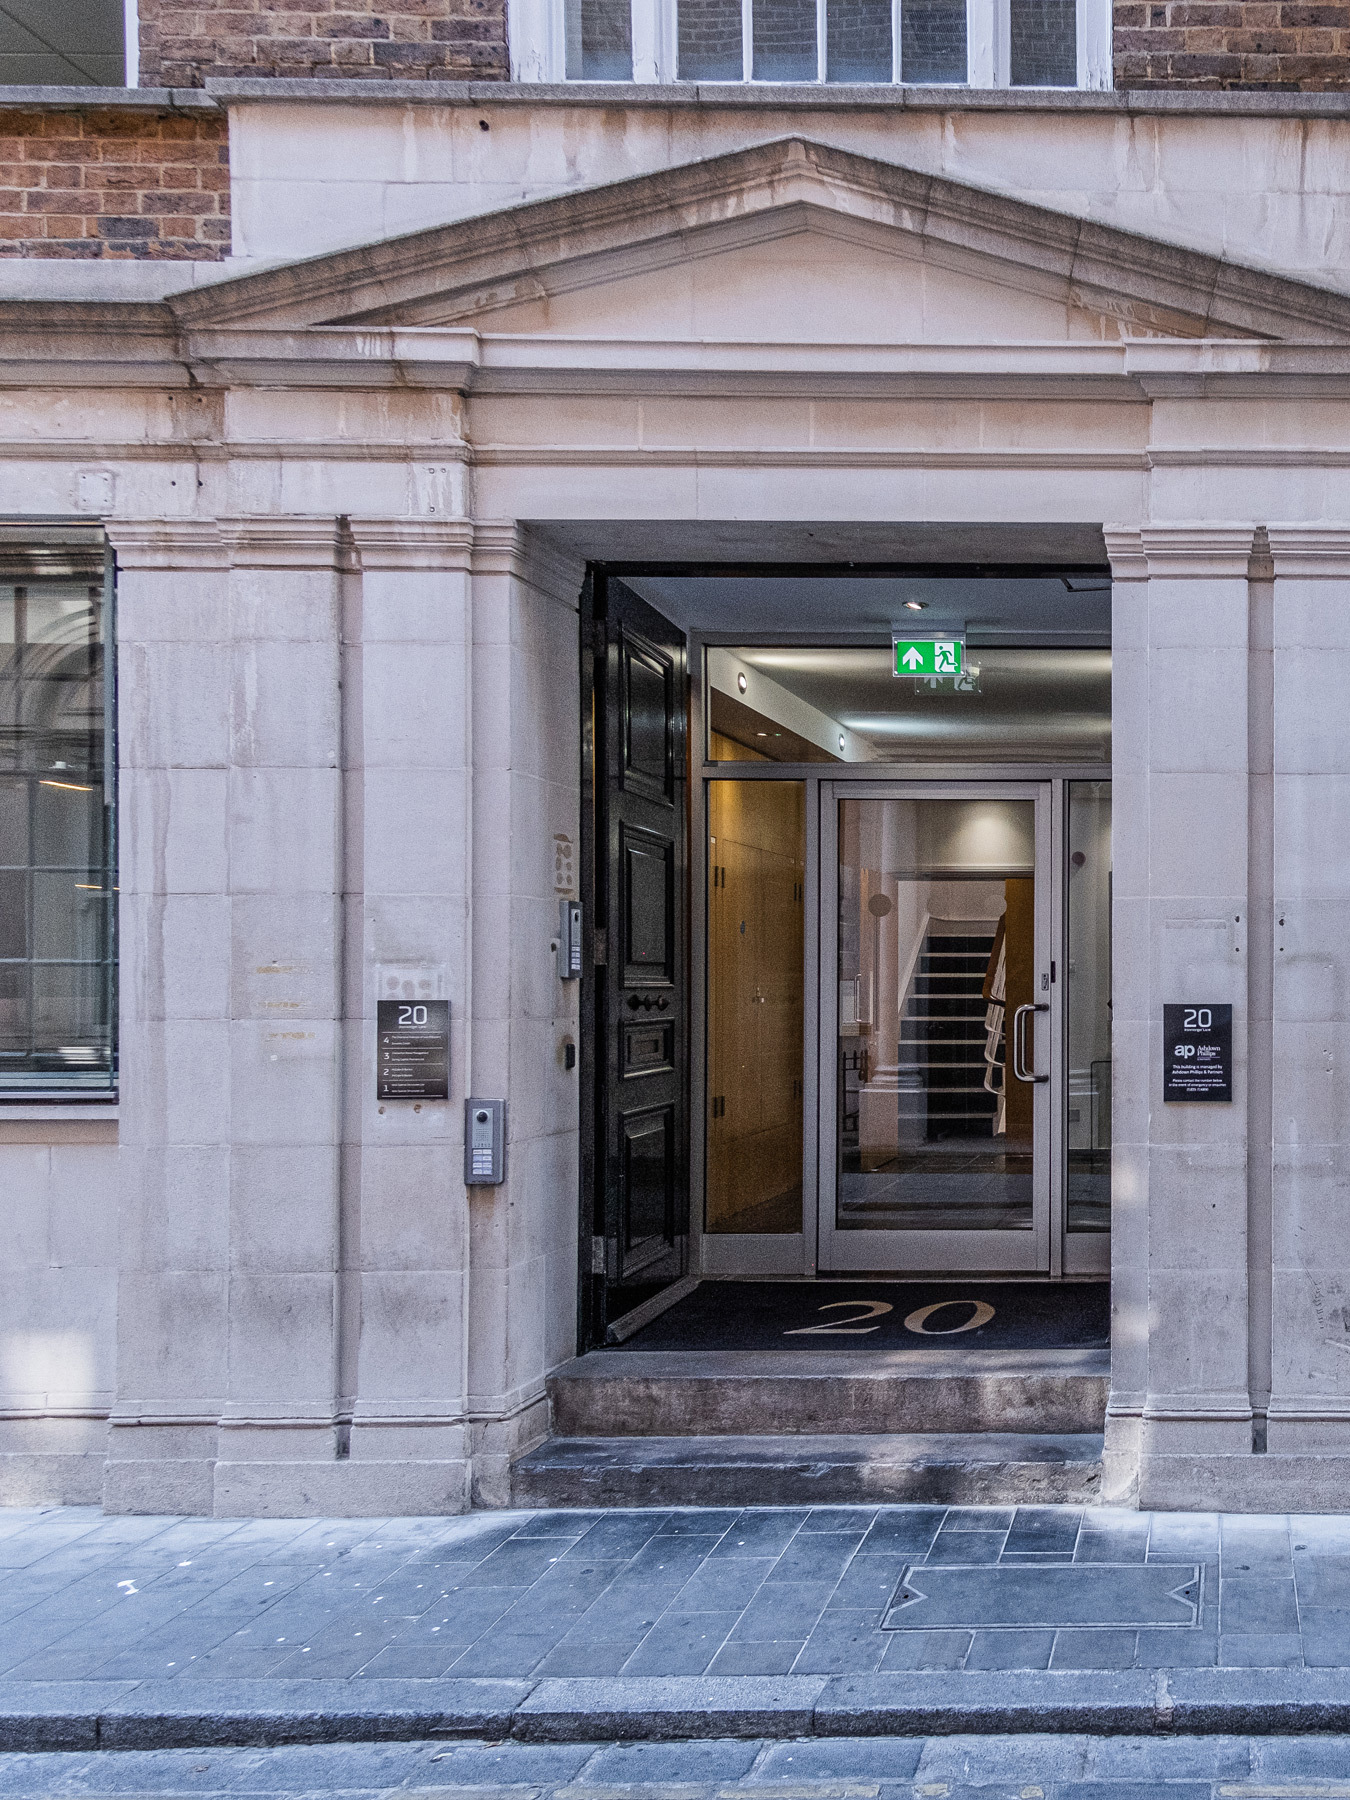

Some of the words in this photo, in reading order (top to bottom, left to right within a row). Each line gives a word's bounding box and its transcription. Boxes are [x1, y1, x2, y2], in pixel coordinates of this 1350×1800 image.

[398, 1005, 428, 1025] 20
[1184, 1009, 1212, 1028] 20
[383, 1036, 390, 1044] 4
[383, 1052, 390, 1060] 3
[1174, 1044, 1195, 1059] ap
[383, 1068, 390, 1076] 2
[383, 1084, 390, 1092] 1
[782, 1299, 996, 1336] 20
